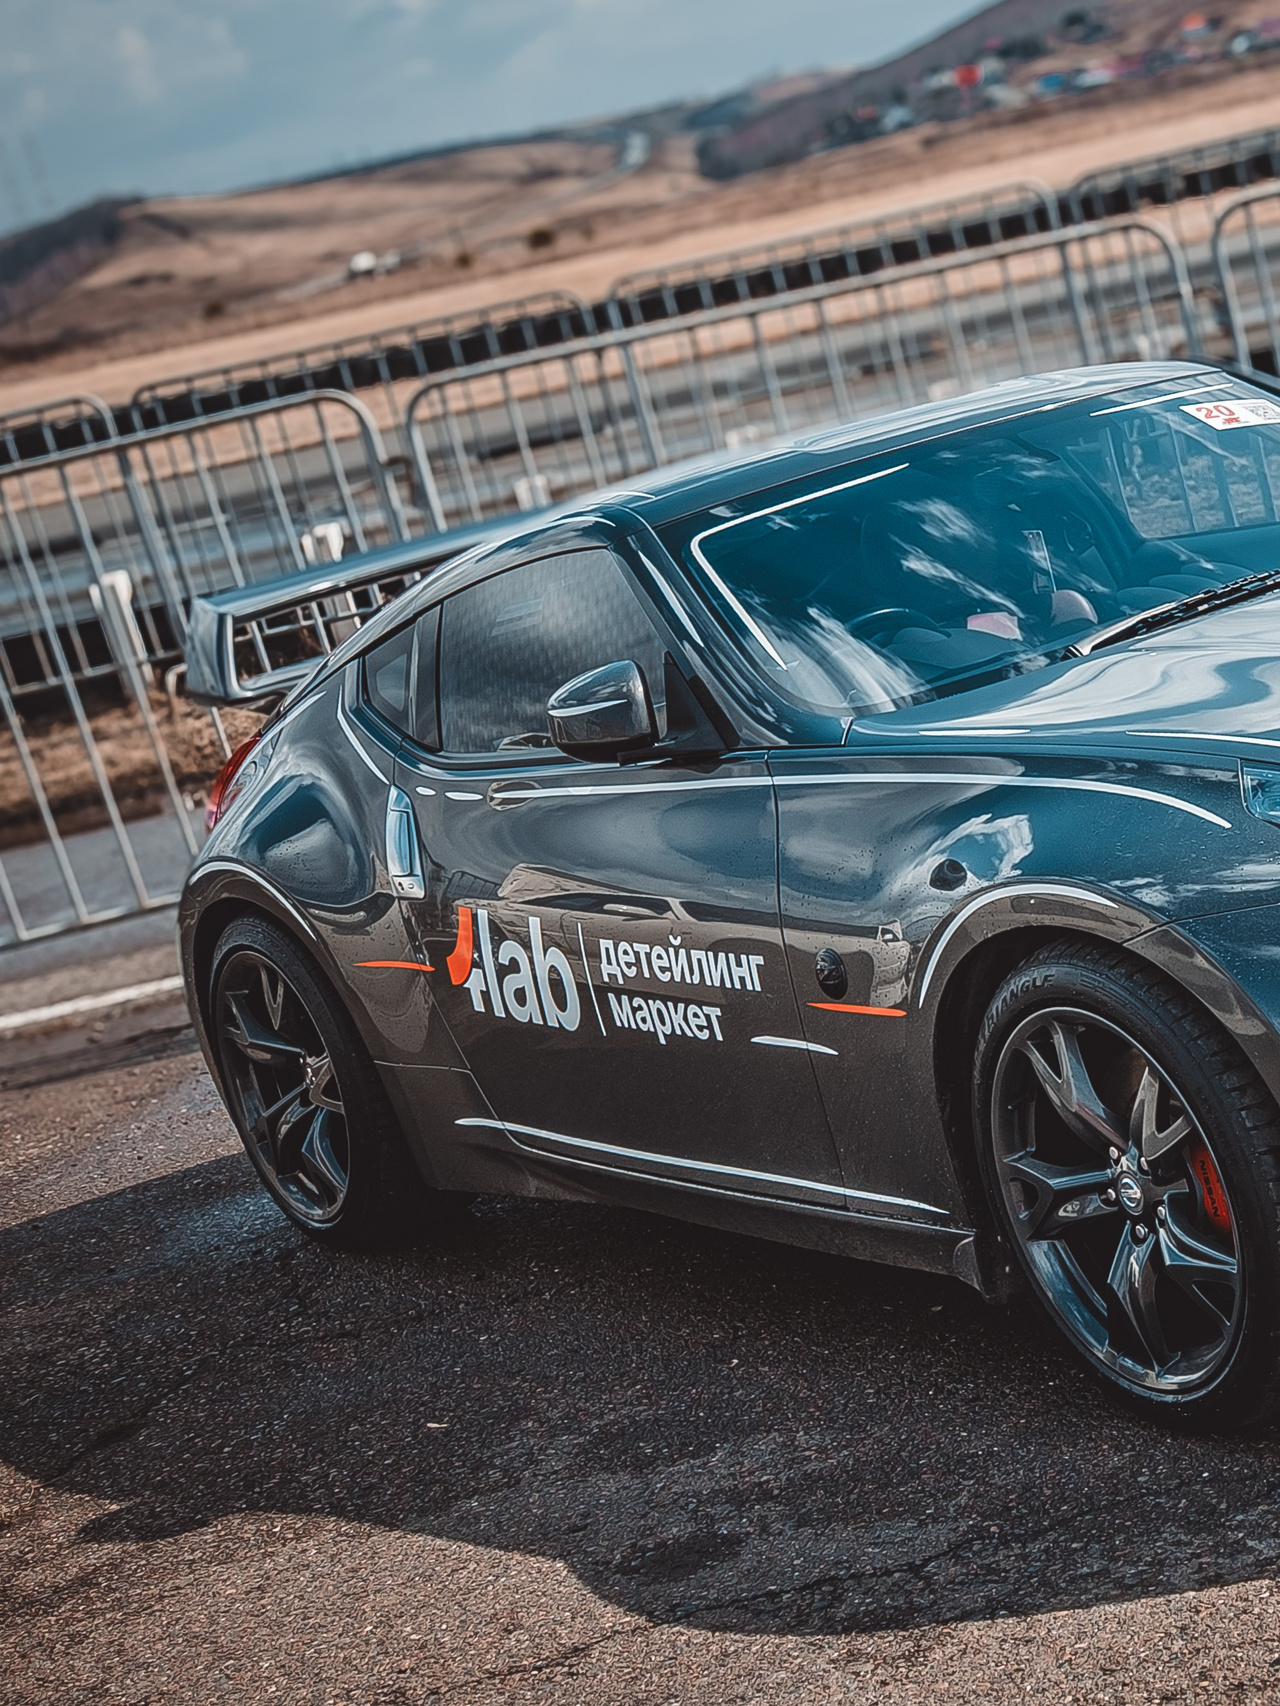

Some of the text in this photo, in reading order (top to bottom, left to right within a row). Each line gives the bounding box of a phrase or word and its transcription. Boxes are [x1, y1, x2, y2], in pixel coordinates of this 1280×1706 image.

[1195, 404, 1236, 420] 20
[600, 934, 765, 992] детейлинг
[607, 992, 724, 1045] маркет
[1199, 1160, 1221, 1218] NISSAN
